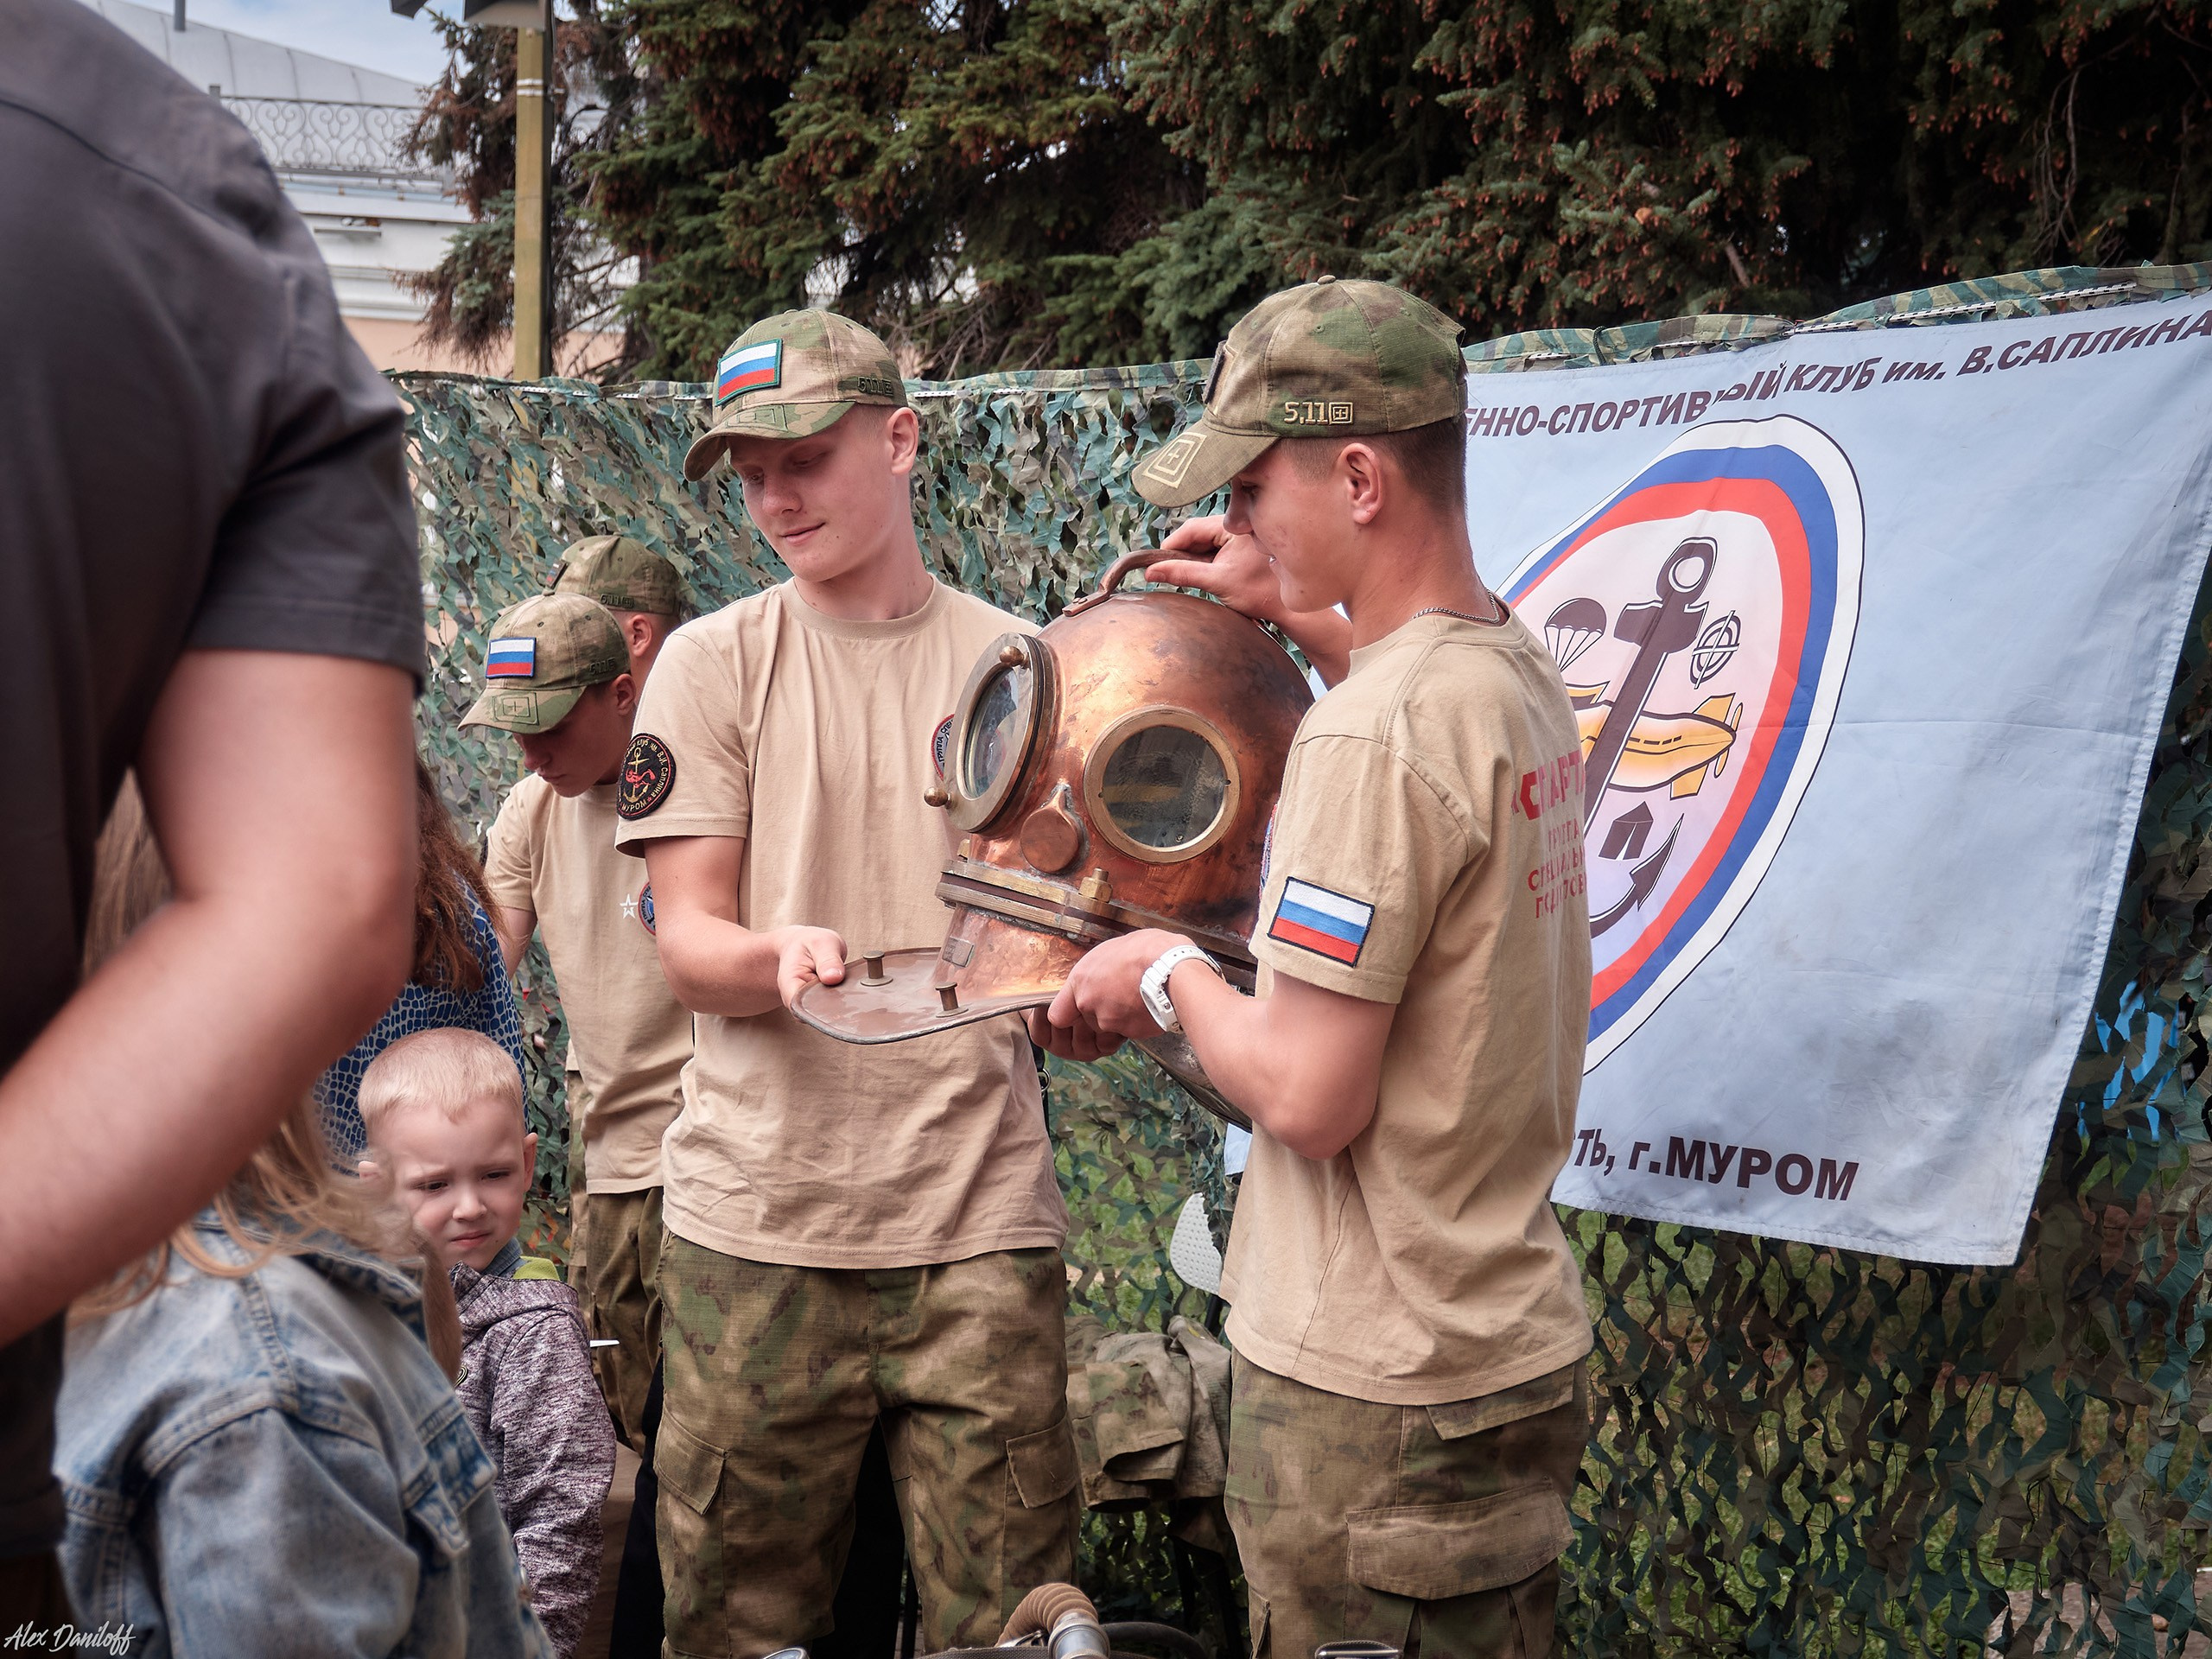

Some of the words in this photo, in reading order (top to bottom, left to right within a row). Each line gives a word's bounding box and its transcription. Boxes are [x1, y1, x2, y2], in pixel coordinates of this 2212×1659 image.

[1465, 360, 1787, 437] ННО-СПОРТИВЫЙ
[1783, 356, 1883, 393] КЛУБ
[1956, 309, 2212, 377] В.САПЛИНА
[1284, 401, 1329, 424] 5.11
[621, 798, 647, 812] МУРОМ
[1573, 1128, 1616, 1176] ТЬ,
